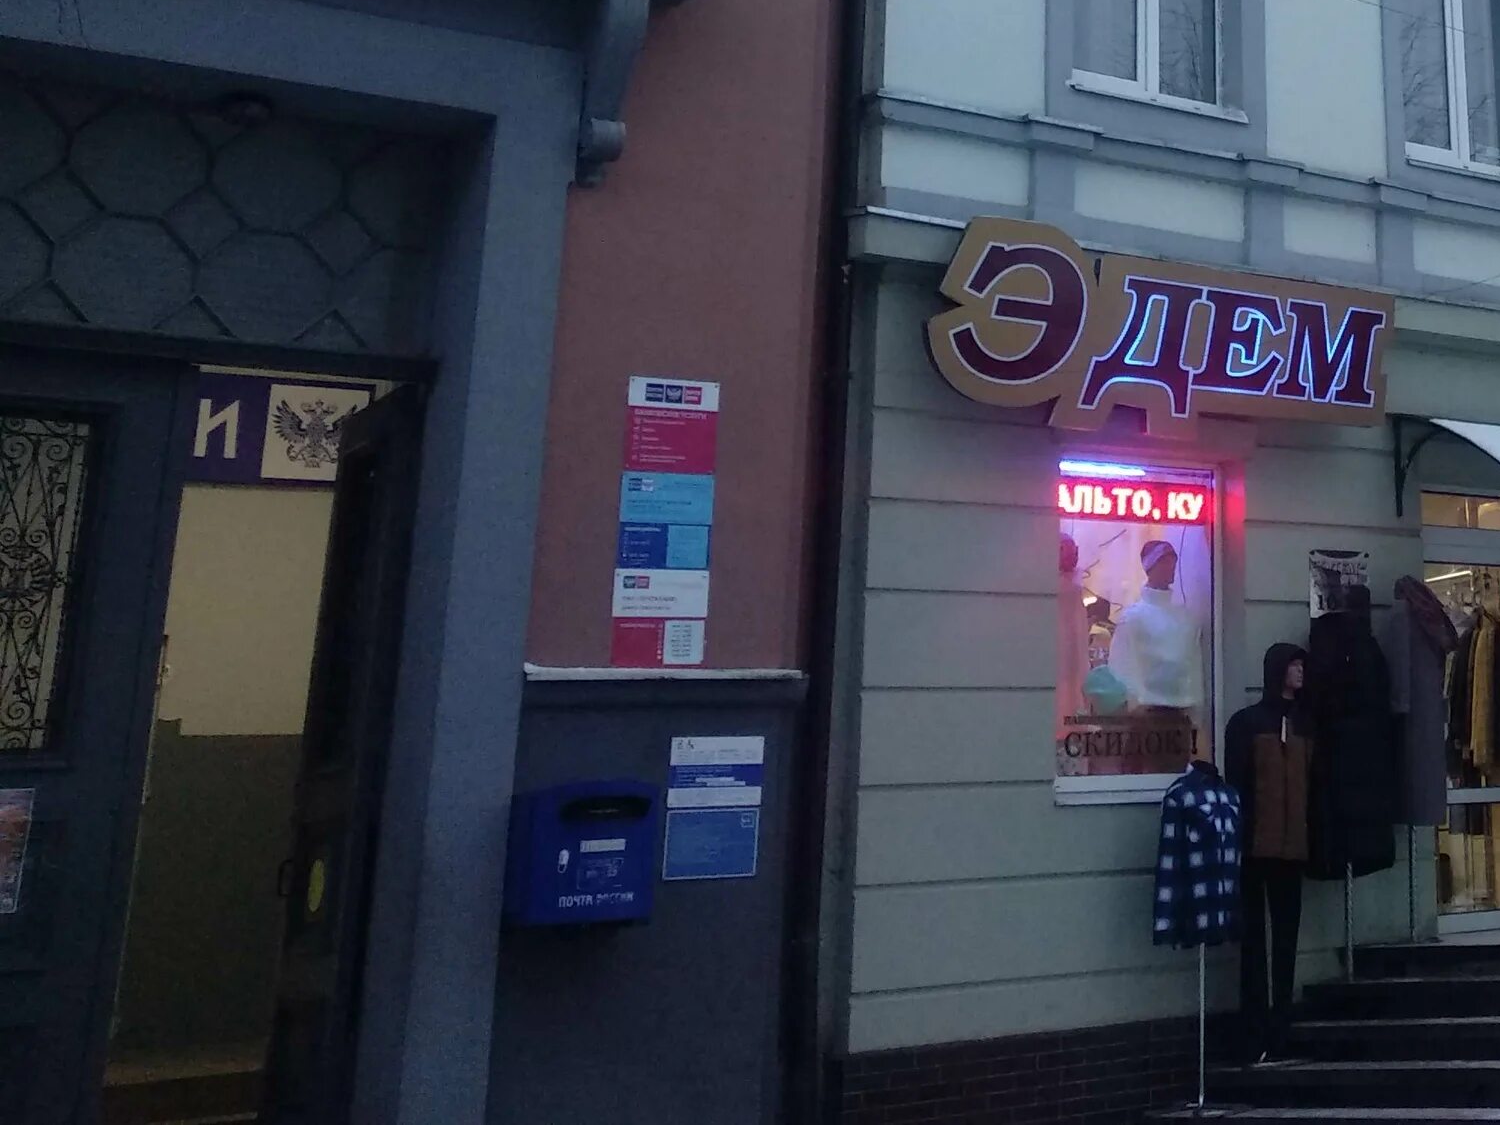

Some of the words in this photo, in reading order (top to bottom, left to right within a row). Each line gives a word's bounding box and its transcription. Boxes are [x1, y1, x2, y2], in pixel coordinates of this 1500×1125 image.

[948, 241, 1386, 418] ЭДЕМ
[1167, 491, 1203, 520] КУ
[558, 894, 593, 908] ПОЧТА
